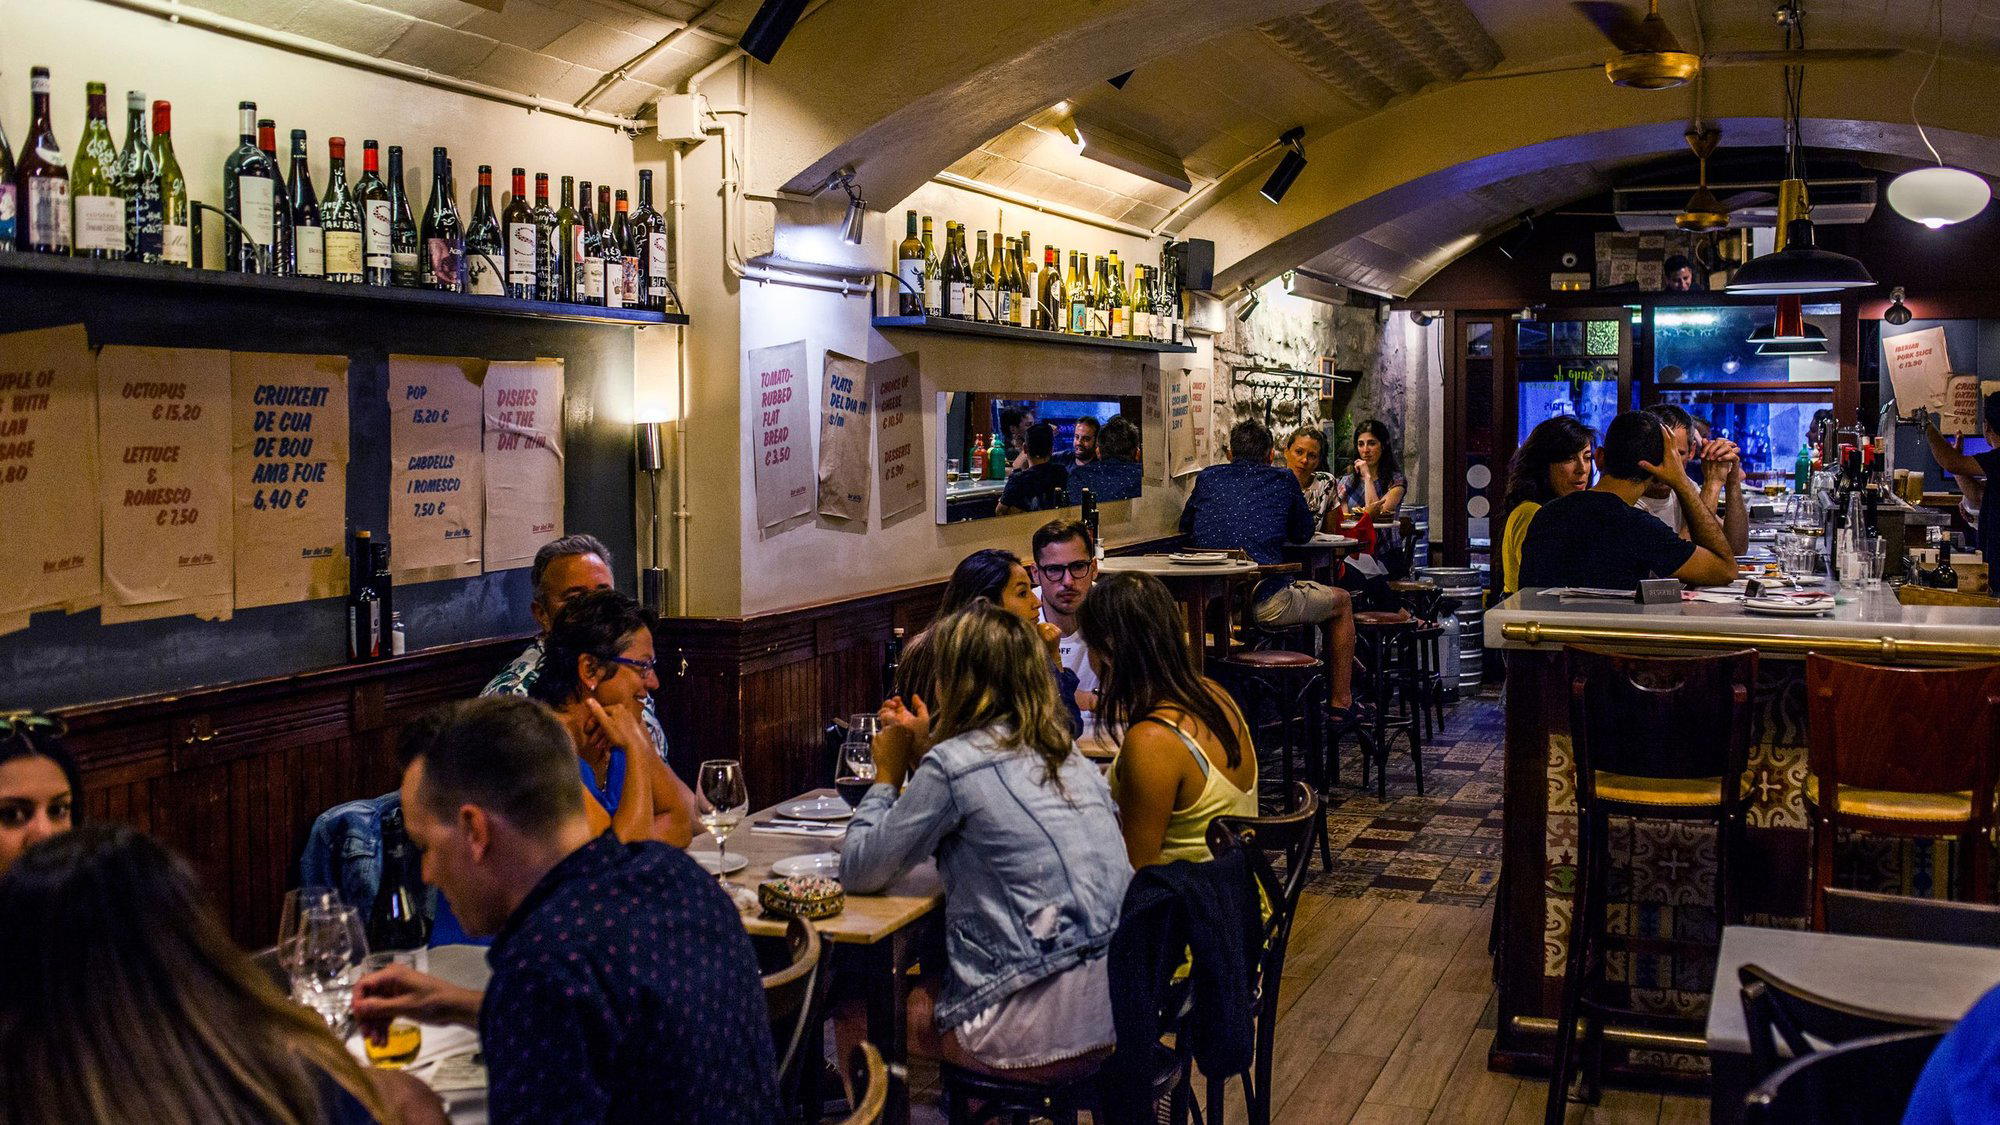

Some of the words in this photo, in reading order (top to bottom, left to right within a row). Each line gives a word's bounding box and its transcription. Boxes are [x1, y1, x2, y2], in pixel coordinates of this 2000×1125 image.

[761, 368, 793, 388] TOMATO-
[831, 374, 853, 394] PLATS
[122, 382, 187, 399] OCTOPUS
[253, 384, 329, 407] CRUIXENT
[406, 384, 428, 400] POP
[497, 388, 538, 407] DISHES
[761, 387, 792, 408] RUBBED
[12, 393, 50, 413] WITH
[829, 393, 844, 410] DEL
[253, 411, 276, 432] DE
[279, 412, 312, 432] CUA
[498, 411, 513, 429] OF
[516, 410, 535, 428] THE
[762, 409, 781, 427] FLAT
[497, 432, 520, 451] DAY
[763, 426, 789, 447] BREAD
[122, 446, 180, 464] LETTUCE
[253, 437, 277, 457] DE
[279, 437, 314, 457] BOU
[765, 450, 772, 467] €
[252, 463, 290, 484] AMB
[292, 462, 328, 483] FOIE
[414, 477, 461, 493] ROMESCO
[123, 487, 191, 507] ROMESCO
[296, 488, 309, 509] €
[438, 501, 446, 515] €
